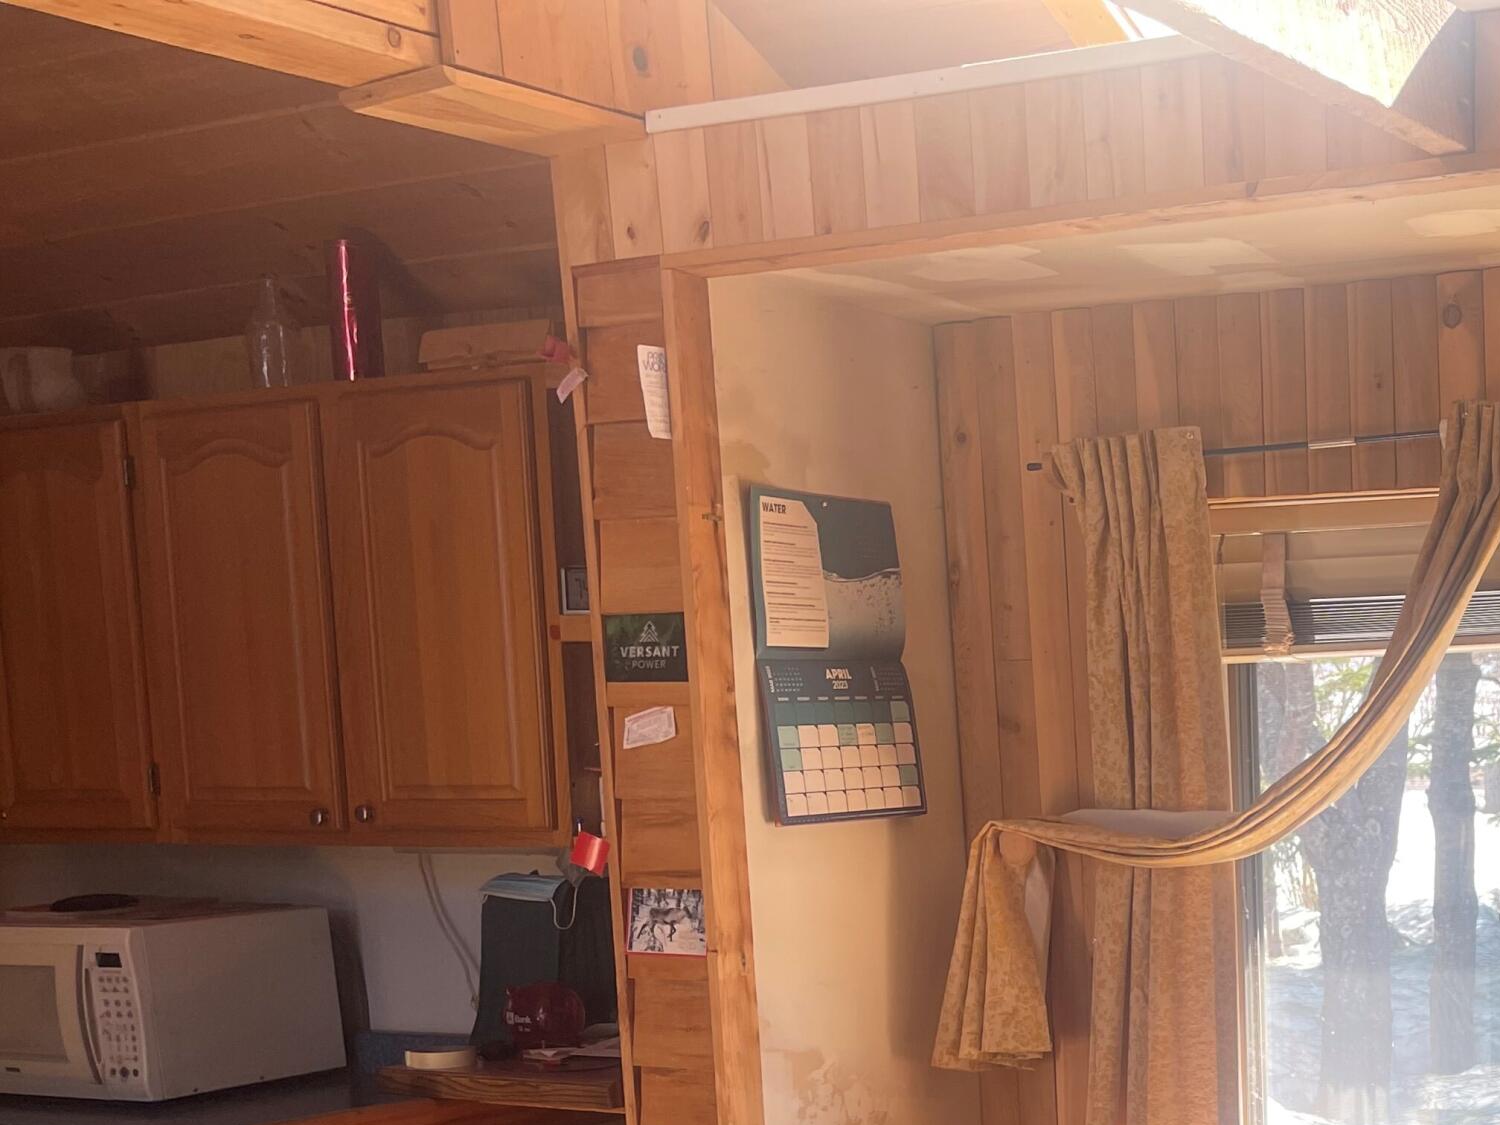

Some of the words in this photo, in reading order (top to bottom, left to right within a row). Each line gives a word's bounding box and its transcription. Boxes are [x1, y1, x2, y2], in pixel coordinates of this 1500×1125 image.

[762, 501, 786, 514] WATER
[620, 645, 680, 658] VERSANT
[632, 659, 667, 669] POWER
[825, 668, 852, 681] APRIL
[832, 680, 848, 690] 2023
